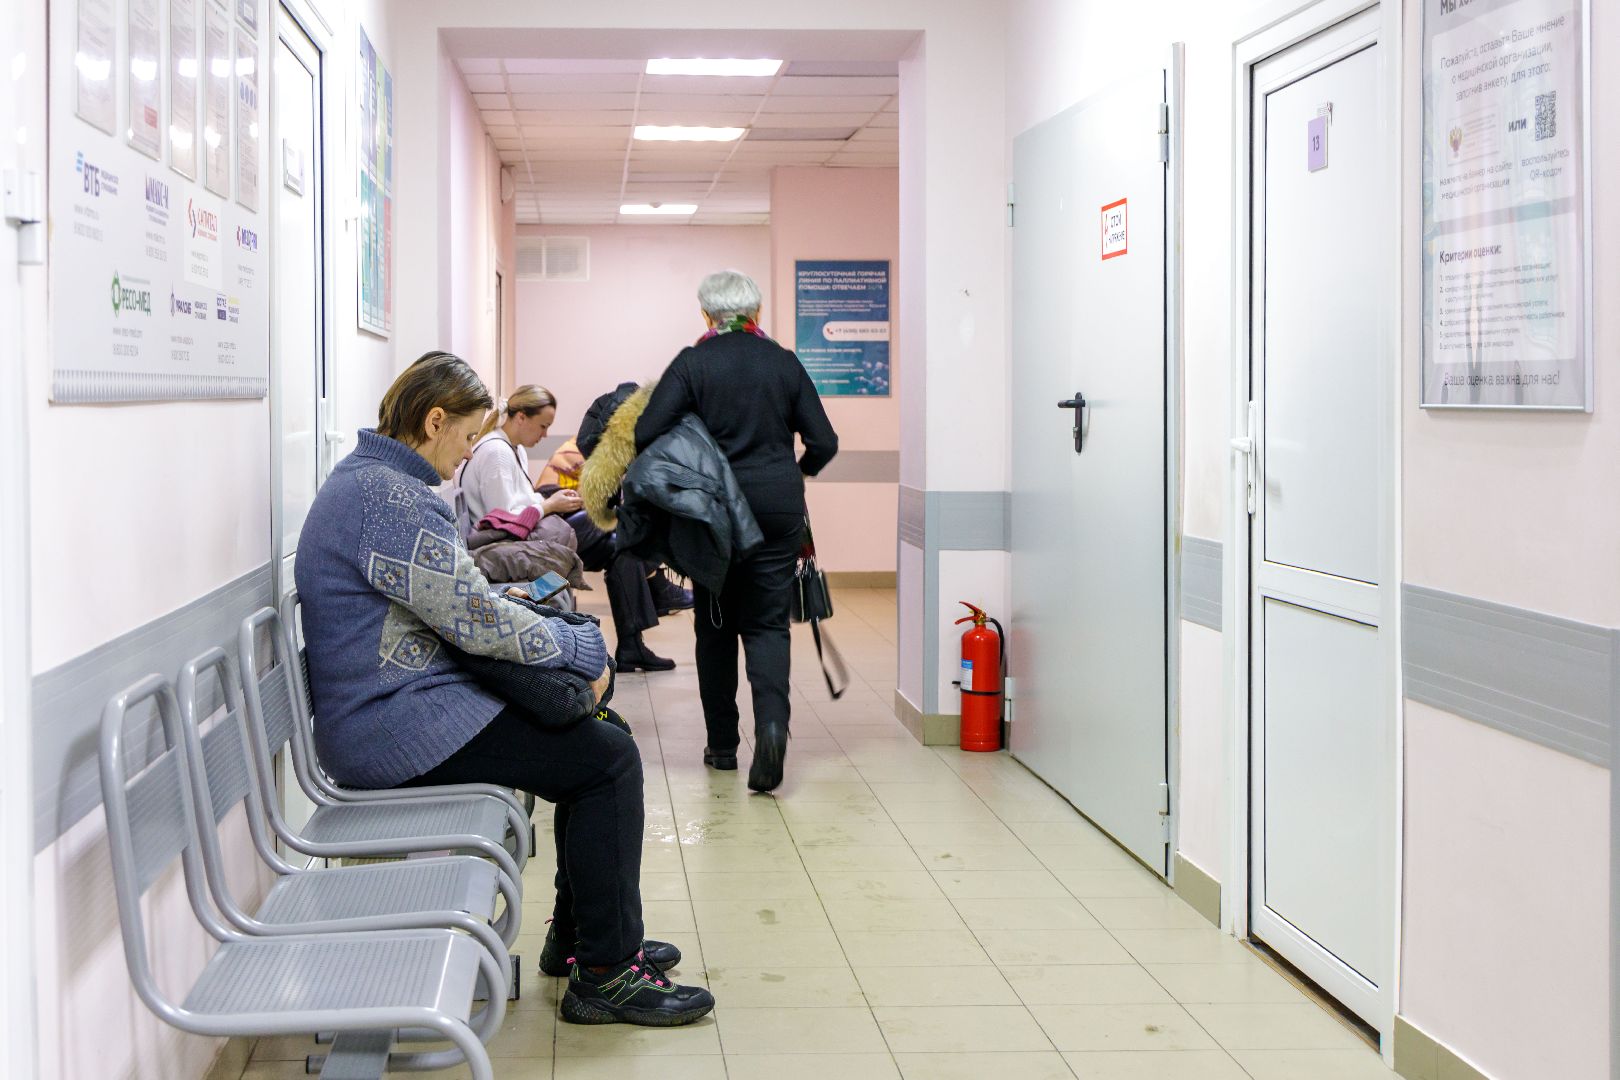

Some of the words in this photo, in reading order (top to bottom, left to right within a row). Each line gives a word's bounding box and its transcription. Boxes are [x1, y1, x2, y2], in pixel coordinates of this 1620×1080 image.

[1511, 25, 1535, 44] Ваше
[1510, 69, 1527, 84] для
[1312, 135, 1320, 152] 13
[84, 161, 100, 197] ВТБ
[1439, 249, 1473, 266] Критерии
[1473, 245, 1502, 259] оценки:
[1466, 374, 1493, 388] оценка
[1521, 374, 1539, 387] для
[1541, 369, 1561, 386] нас!
